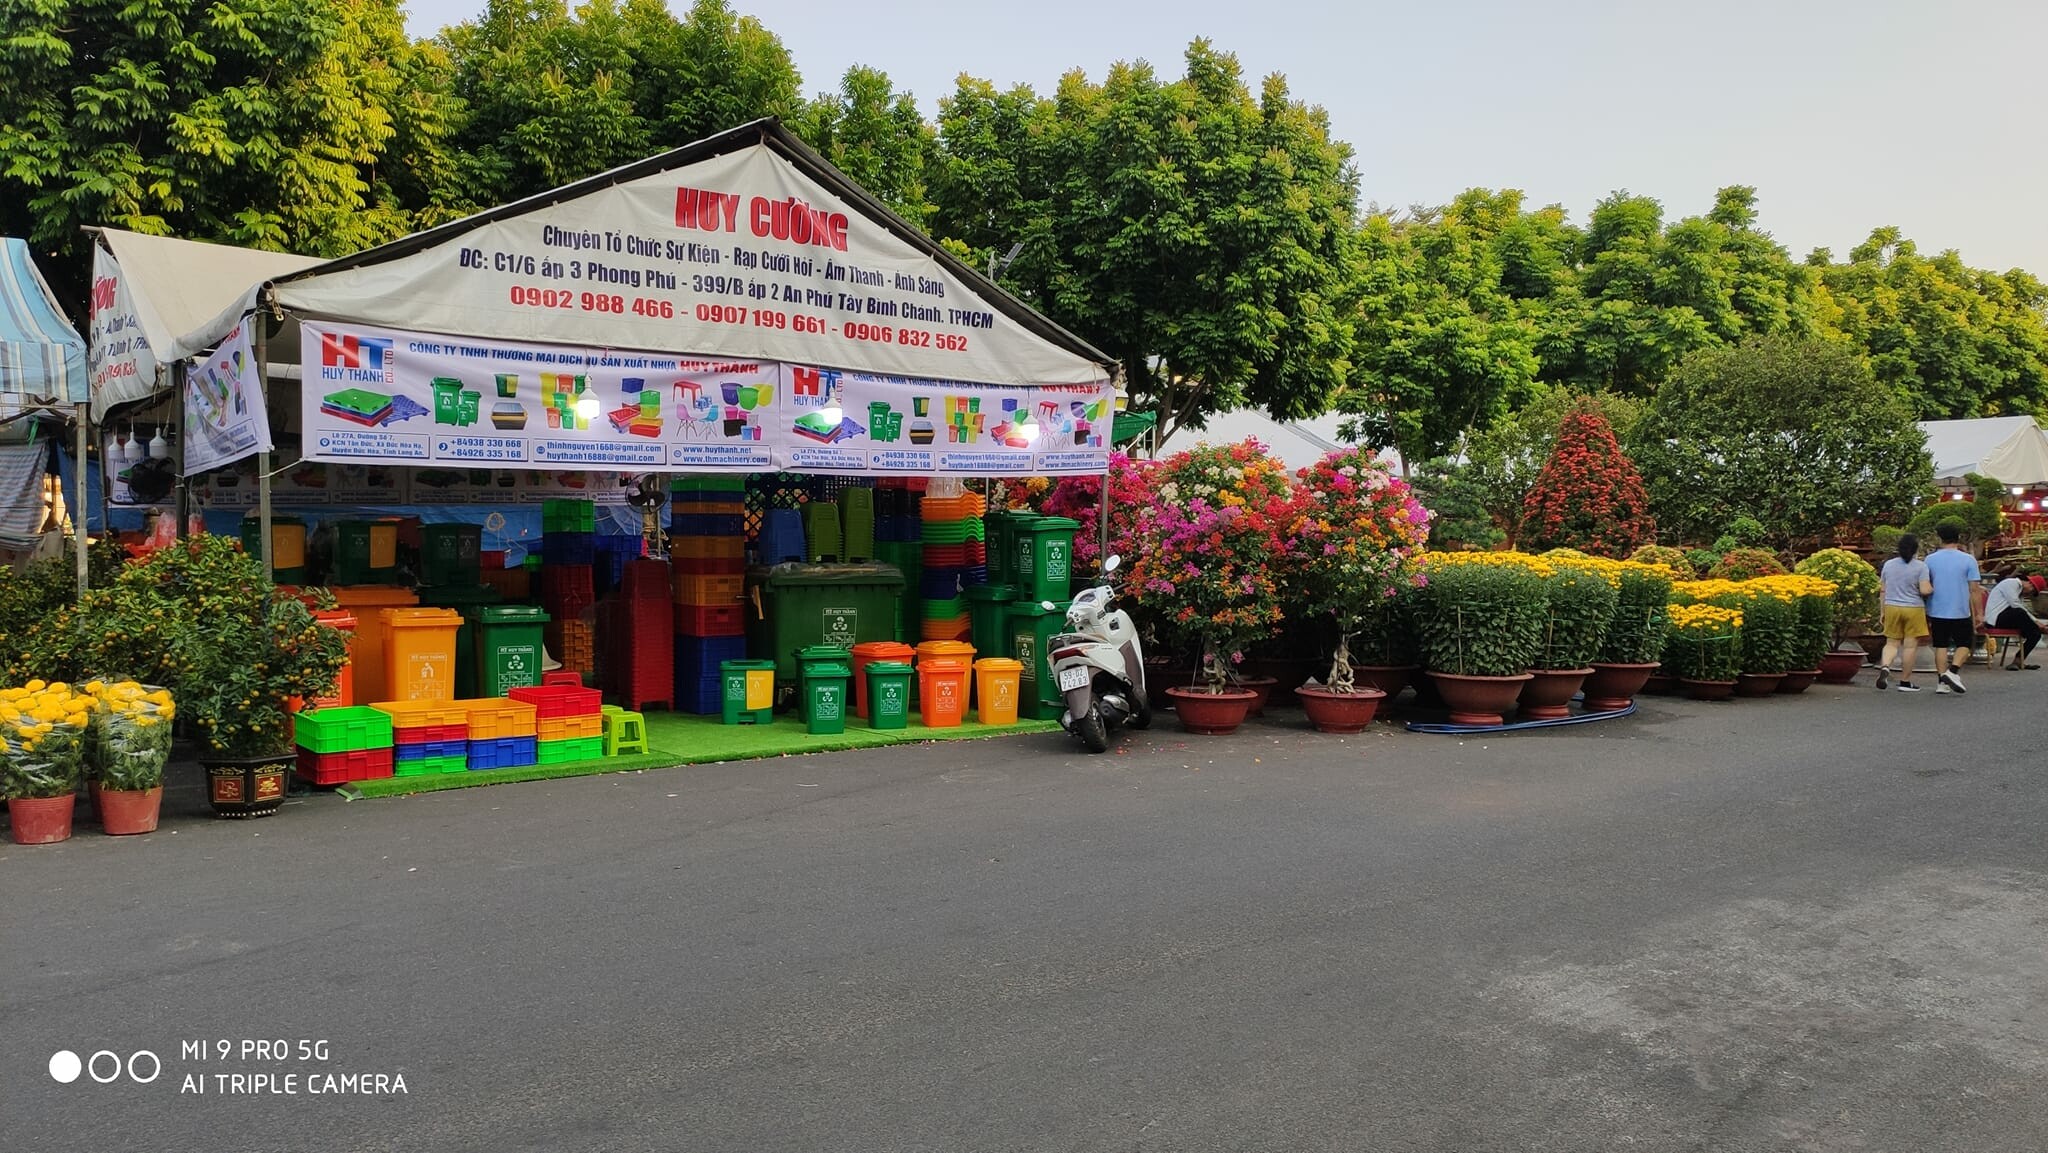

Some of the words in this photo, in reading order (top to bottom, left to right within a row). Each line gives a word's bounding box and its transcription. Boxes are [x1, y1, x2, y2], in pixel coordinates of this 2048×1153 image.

[675, 186, 741, 234] HUY
[749, 195, 850, 252] CƯỜNG
[543, 224, 601, 250] Chuyên
[605, 227, 623, 253] Tổ
[626, 234, 661, 258] Chức
[666, 240, 686, 265] Sự
[688, 241, 720, 268] Kiện
[734, 247, 757, 271] Rạp
[762, 250, 790, 273] Cưới
[794, 256, 813, 278] Hỏi
[825, 258, 846, 282] Âm
[848, 266, 884, 288] Thanh
[918, 276, 945, 298] Sáng
[460, 248, 488, 270] ĐC:
[494, 252, 535, 276] C1/6
[541, 254, 564, 280] ấp
[570, 260, 582, 280] 3
[588, 262, 641, 288] Phong
[646, 269, 676, 290] Phú
[692, 274, 744, 296] 399/B
[748, 277, 766, 300] ấp
[770, 284, 780, 301] 2
[783, 284, 802, 304] An
[806, 288, 833, 310] Phú
[838, 292, 863, 314] Tây
[948, 308, 994, 330] TPHCM
[510, 286, 574, 310] 0902
[580, 292, 624, 315] 988
[632, 297, 674, 320] 466
[696, 302, 748, 326] 0907
[752, 308, 786, 330] 199
[792, 313, 826, 335] 661
[844, 320, 893, 344] 0906
[898, 327, 931, 348] 832
[936, 332, 968, 353] 562
[322, 332, 394, 371] HT
[410, 342, 441, 355] CÔNG
[444, 344, 457, 356] TY
[460, 346, 488, 358] TNHH
[491, 348, 534, 362] THƯƠNG
[536, 352, 556, 365] MẠI
[624, 356, 649, 369] XUẤT
[322, 366, 344, 380] HUY
[792, 367, 843, 397] HT
[794, 396, 809, 406] HUY
[451, 440, 485, 450] +84938
[487, 440, 503, 450] 330
[505, 441, 522, 452] 668
[451, 450, 485, 460] +84926
[487, 451, 504, 460] 335
[506, 452, 522, 461] 168
[683, 444, 752, 456] www.huythanh.net
[683, 454, 768, 465] www.thmachinery.com
